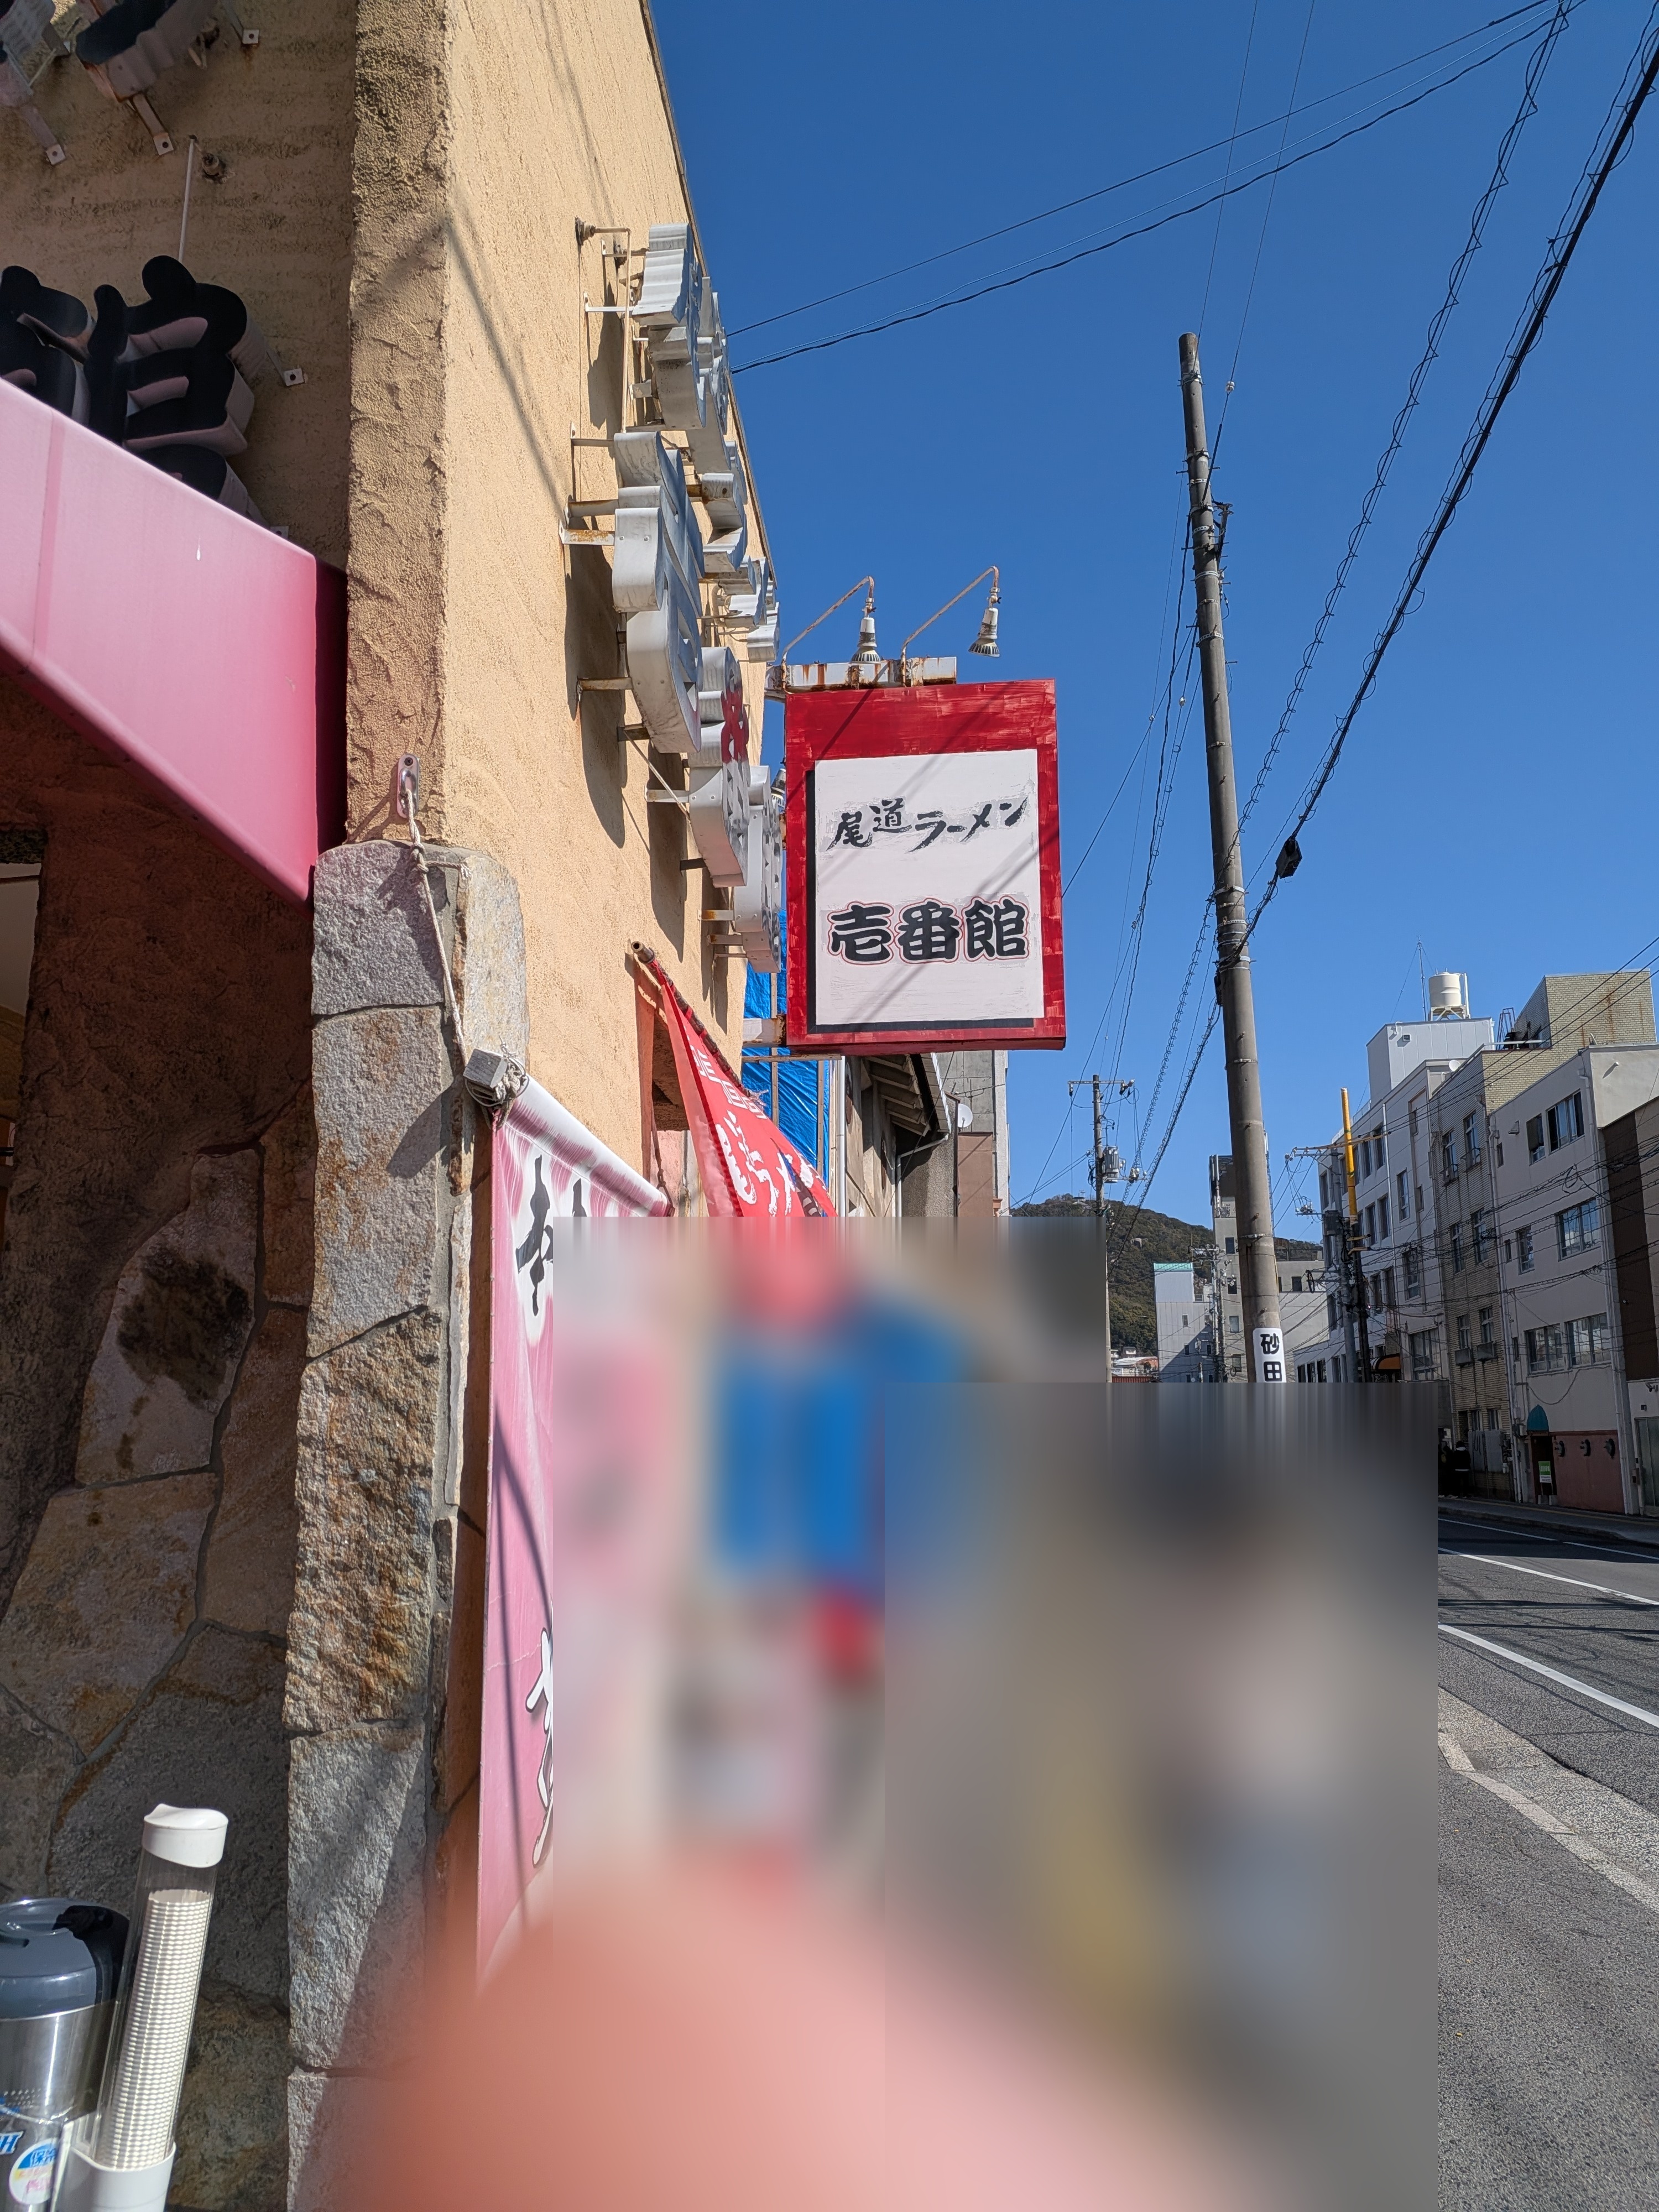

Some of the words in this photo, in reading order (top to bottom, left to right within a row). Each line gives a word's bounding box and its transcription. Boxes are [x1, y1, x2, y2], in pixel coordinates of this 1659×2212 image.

[826, 797, 1030, 853] 尾道ラーメン
[828, 896, 1030, 964] 壱番館
[1260, 1333, 1282, 1382] 砂田
